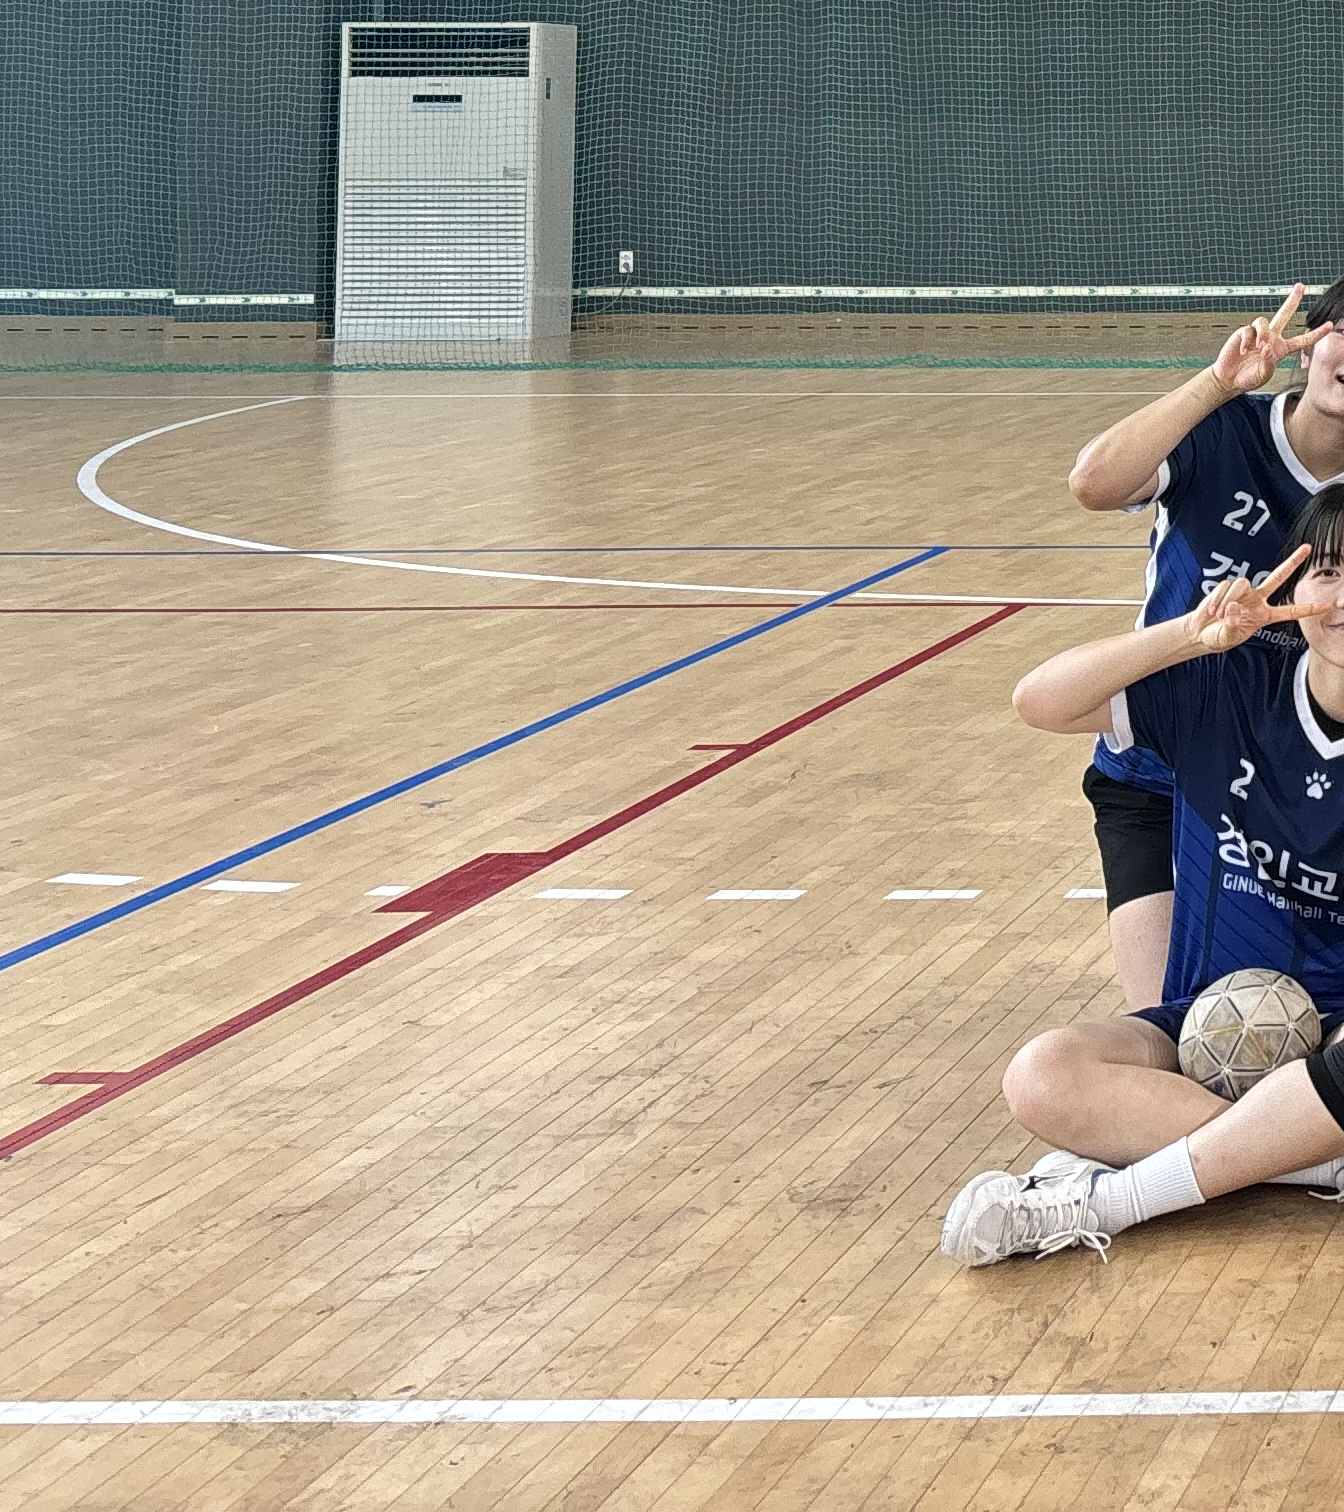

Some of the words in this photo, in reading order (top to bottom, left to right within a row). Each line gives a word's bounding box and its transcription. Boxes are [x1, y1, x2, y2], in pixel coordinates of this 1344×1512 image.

[1222, 490, 1271, 537] 27
[1230, 758, 1256, 802] 2
[1222, 872, 1266, 899] GINUE
